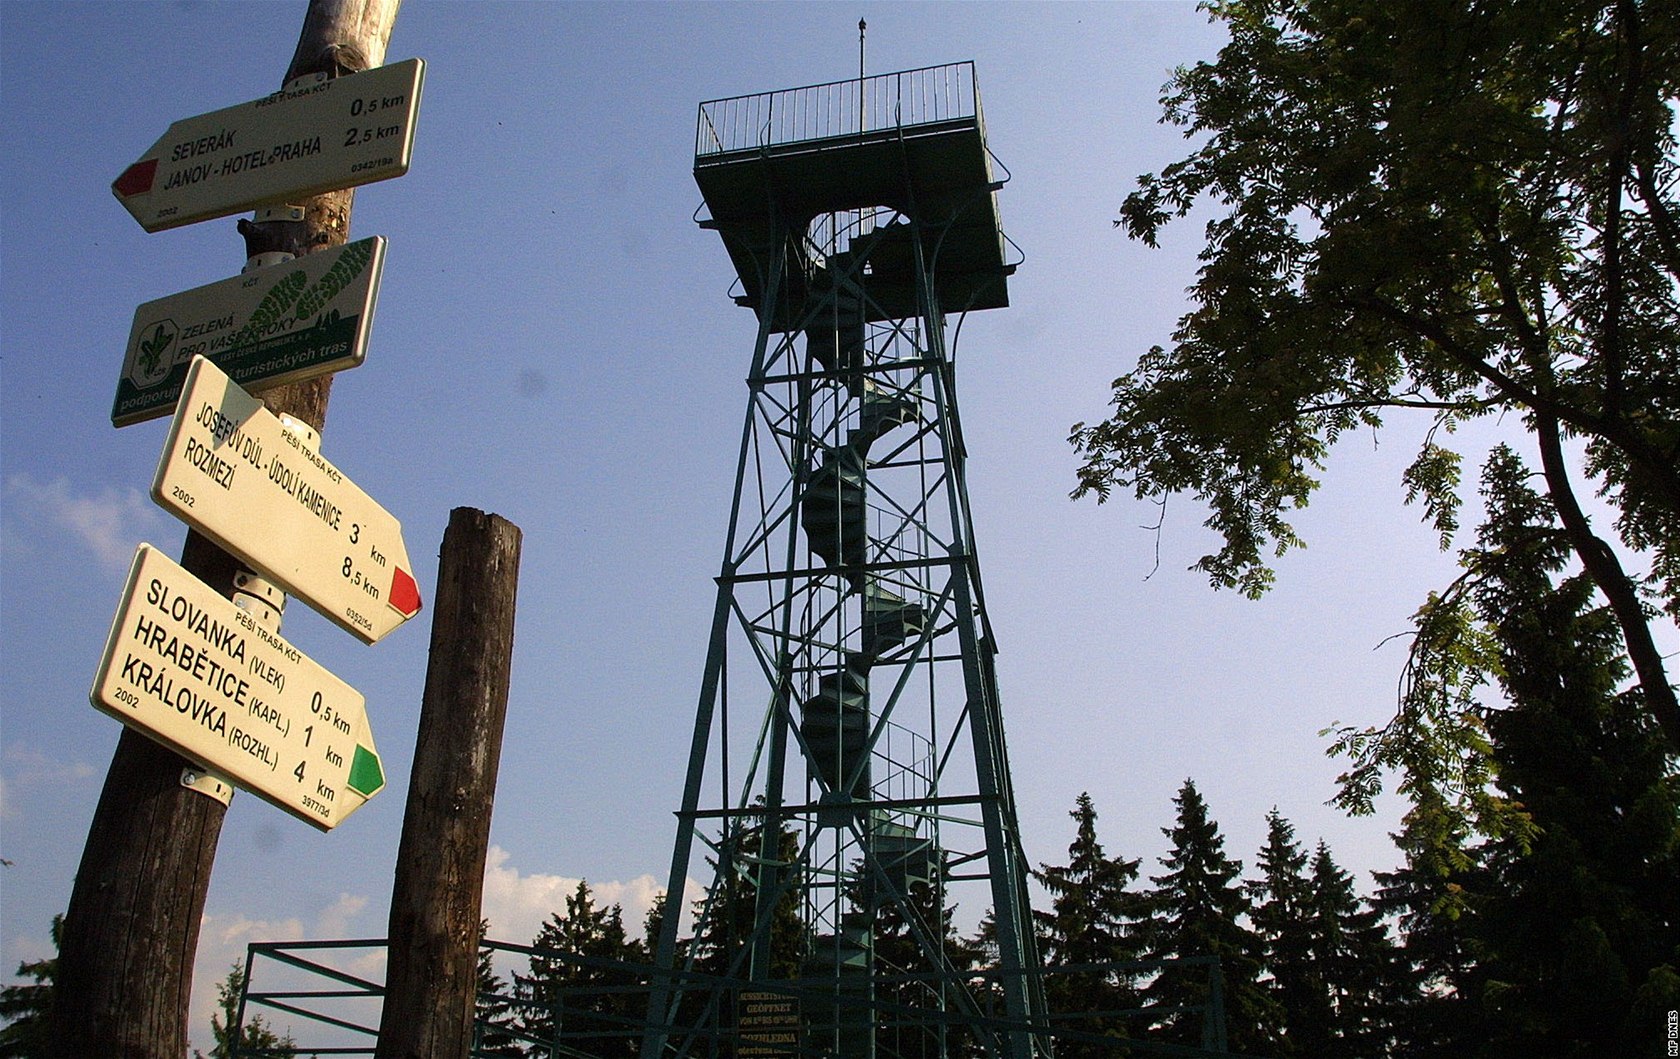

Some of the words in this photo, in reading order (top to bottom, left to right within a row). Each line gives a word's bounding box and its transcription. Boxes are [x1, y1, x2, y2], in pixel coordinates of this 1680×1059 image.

[163, 165, 213, 191] JANOV
[221, 151, 269, 177] HOTEL
[272, 136, 321, 163] PRAHA
[343, 128, 373, 147] 2,5
[376, 123, 400, 140] km
[171, 129, 237, 162] SEVERÁK
[350, 98, 378, 117] 0,5
[381, 92, 404, 109] km
[176, 339, 207, 361] PRO
[180, 311, 235, 341] ZELENÁ
[235, 347, 316, 380] turistických
[319, 340, 347, 358] tras
[280, 428, 301, 449] PĚŠÍ
[300, 445, 327, 470] TRASA
[326, 466, 342, 485] KČT
[172, 485, 196, 508] 2002
[184, 436, 238, 491] ROZMEZÍ
[341, 556, 362, 586] 8,5
[361, 577, 380, 600] km
[243, 438, 263, 470] DŮL
[269, 456, 299, 497] ÚDOLÍ
[296, 481, 343, 531] KAMENICE
[348, 523, 361, 545] 3
[370, 545, 387, 568] km
[147, 578, 247, 665] SLOVANKA
[248, 655, 286, 694] (VLEK)
[310, 690, 332, 723] 0,5
[332, 711, 351, 736] km
[233, 611, 256, 635] PĚŠÍ
[256, 625, 285, 654] TRASA
[283, 647, 303, 665] KČT
[114, 687, 140, 709] 2002
[133, 615, 250, 709] HRABĚTICE
[248, 696, 291, 738] (KAPL.)
[303, 724, 314, 748] 1
[325, 745, 344, 769] km
[120, 653, 227, 739] KRÁLOVKA
[228, 725, 280, 772] (ROZHL.)
[293, 759, 307, 783] 4
[315, 778, 336, 802] km
